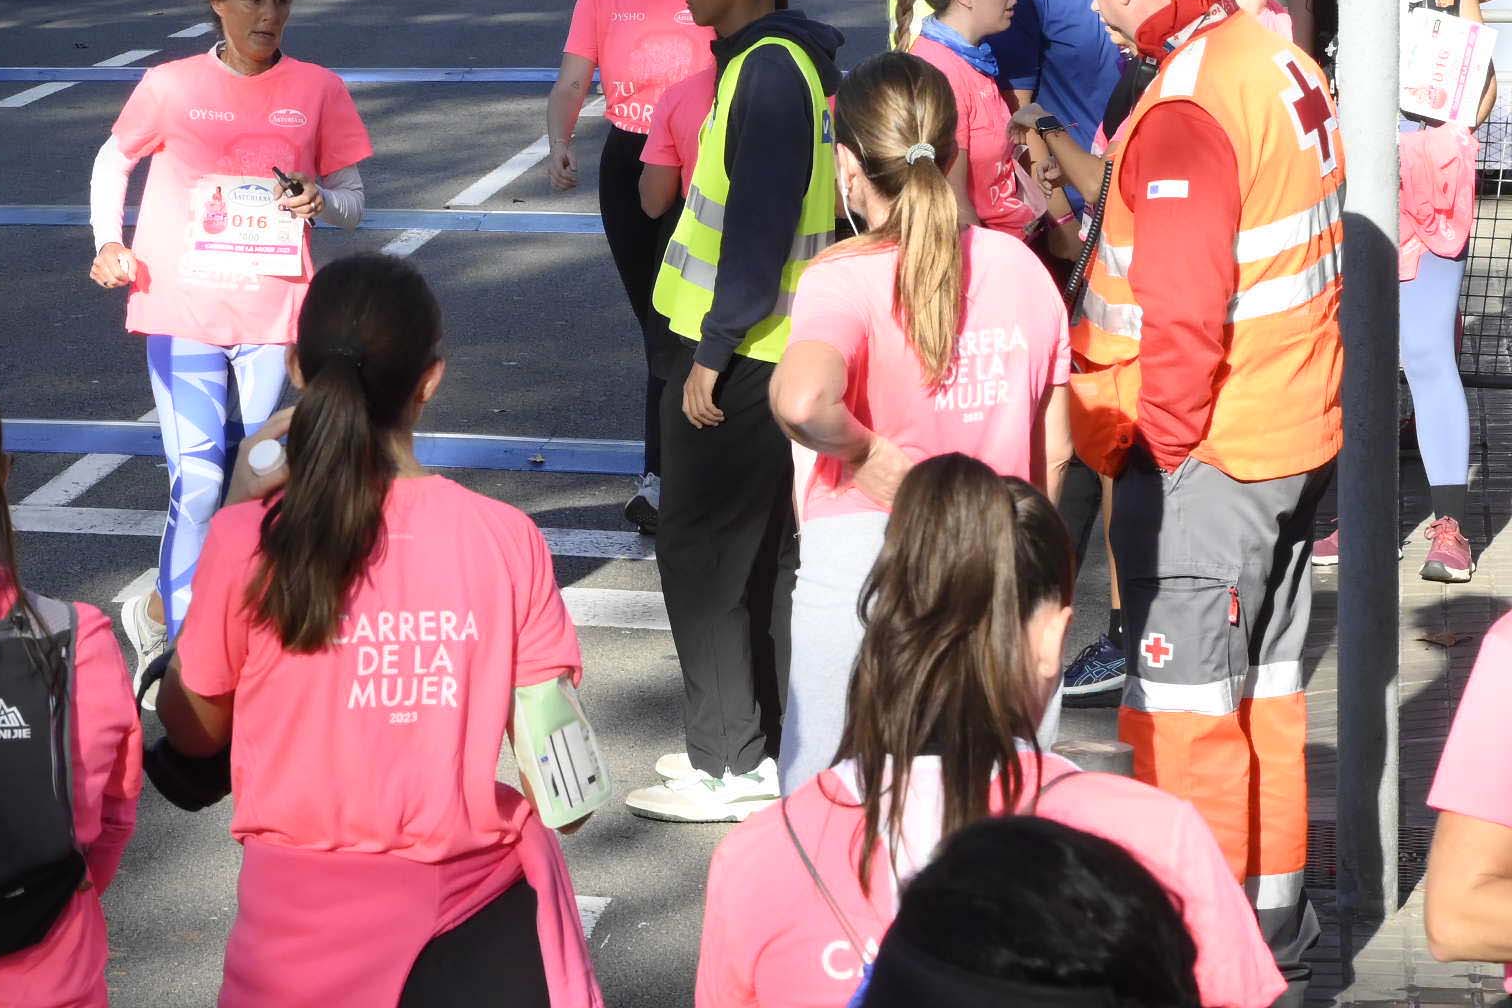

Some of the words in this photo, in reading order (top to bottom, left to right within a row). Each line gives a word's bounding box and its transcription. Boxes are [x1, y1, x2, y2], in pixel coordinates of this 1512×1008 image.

[189, 107, 235, 123] OYSHO
[232, 214, 268, 229] 016
[976, 353, 1006, 381] LA
[934, 379, 1010, 411] MUJER
[357, 644, 400, 677] DE
[413, 642, 455, 675] LA
[346, 675, 459, 710] MUJER
[388, 711, 419, 724] 2023
